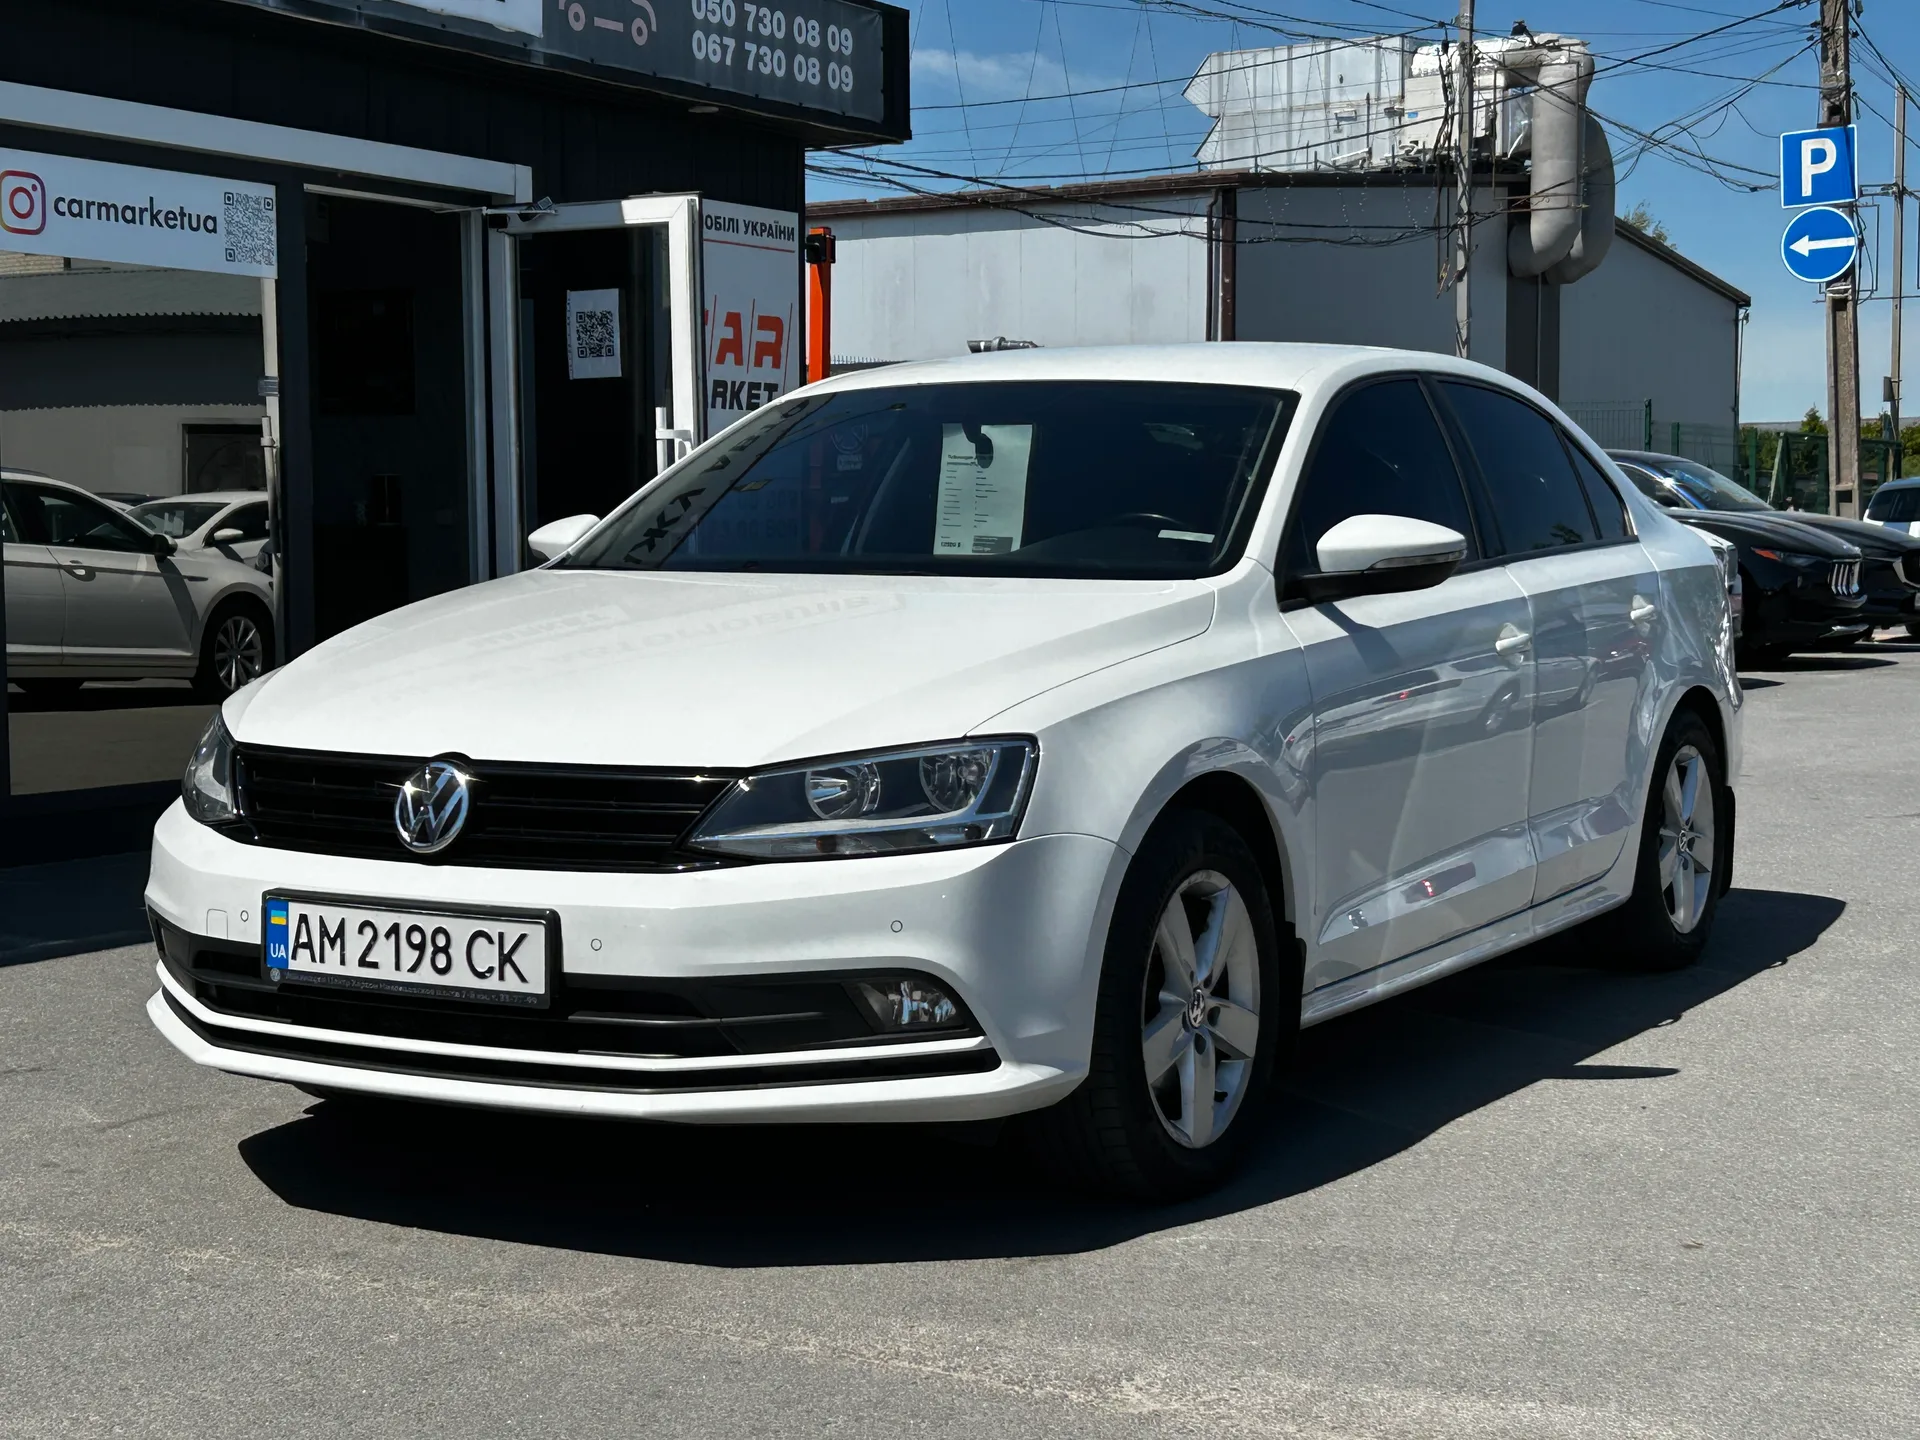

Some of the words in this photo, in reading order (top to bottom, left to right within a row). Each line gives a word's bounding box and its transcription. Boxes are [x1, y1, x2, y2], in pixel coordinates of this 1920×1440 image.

[692, 0, 736, 27] 050
[744, 3, 786, 39] 730
[793, 16, 821, 47] 08
[827, 24, 853, 56] 09
[692, 30, 736, 66] 067
[744, 42, 786, 77] 730
[793, 54, 821, 85] 08
[827, 61, 854, 93] 09
[1801, 137, 1837, 197] P
[53, 196, 218, 235] carmarketua
[743, 219, 795, 242] УКРАЇНИ
[704, 308, 784, 370] AR
[270, 942, 287, 960] UA
[290, 912, 346, 967] AM
[357, 918, 452, 977] 2198
[465, 928, 529, 984] CK
